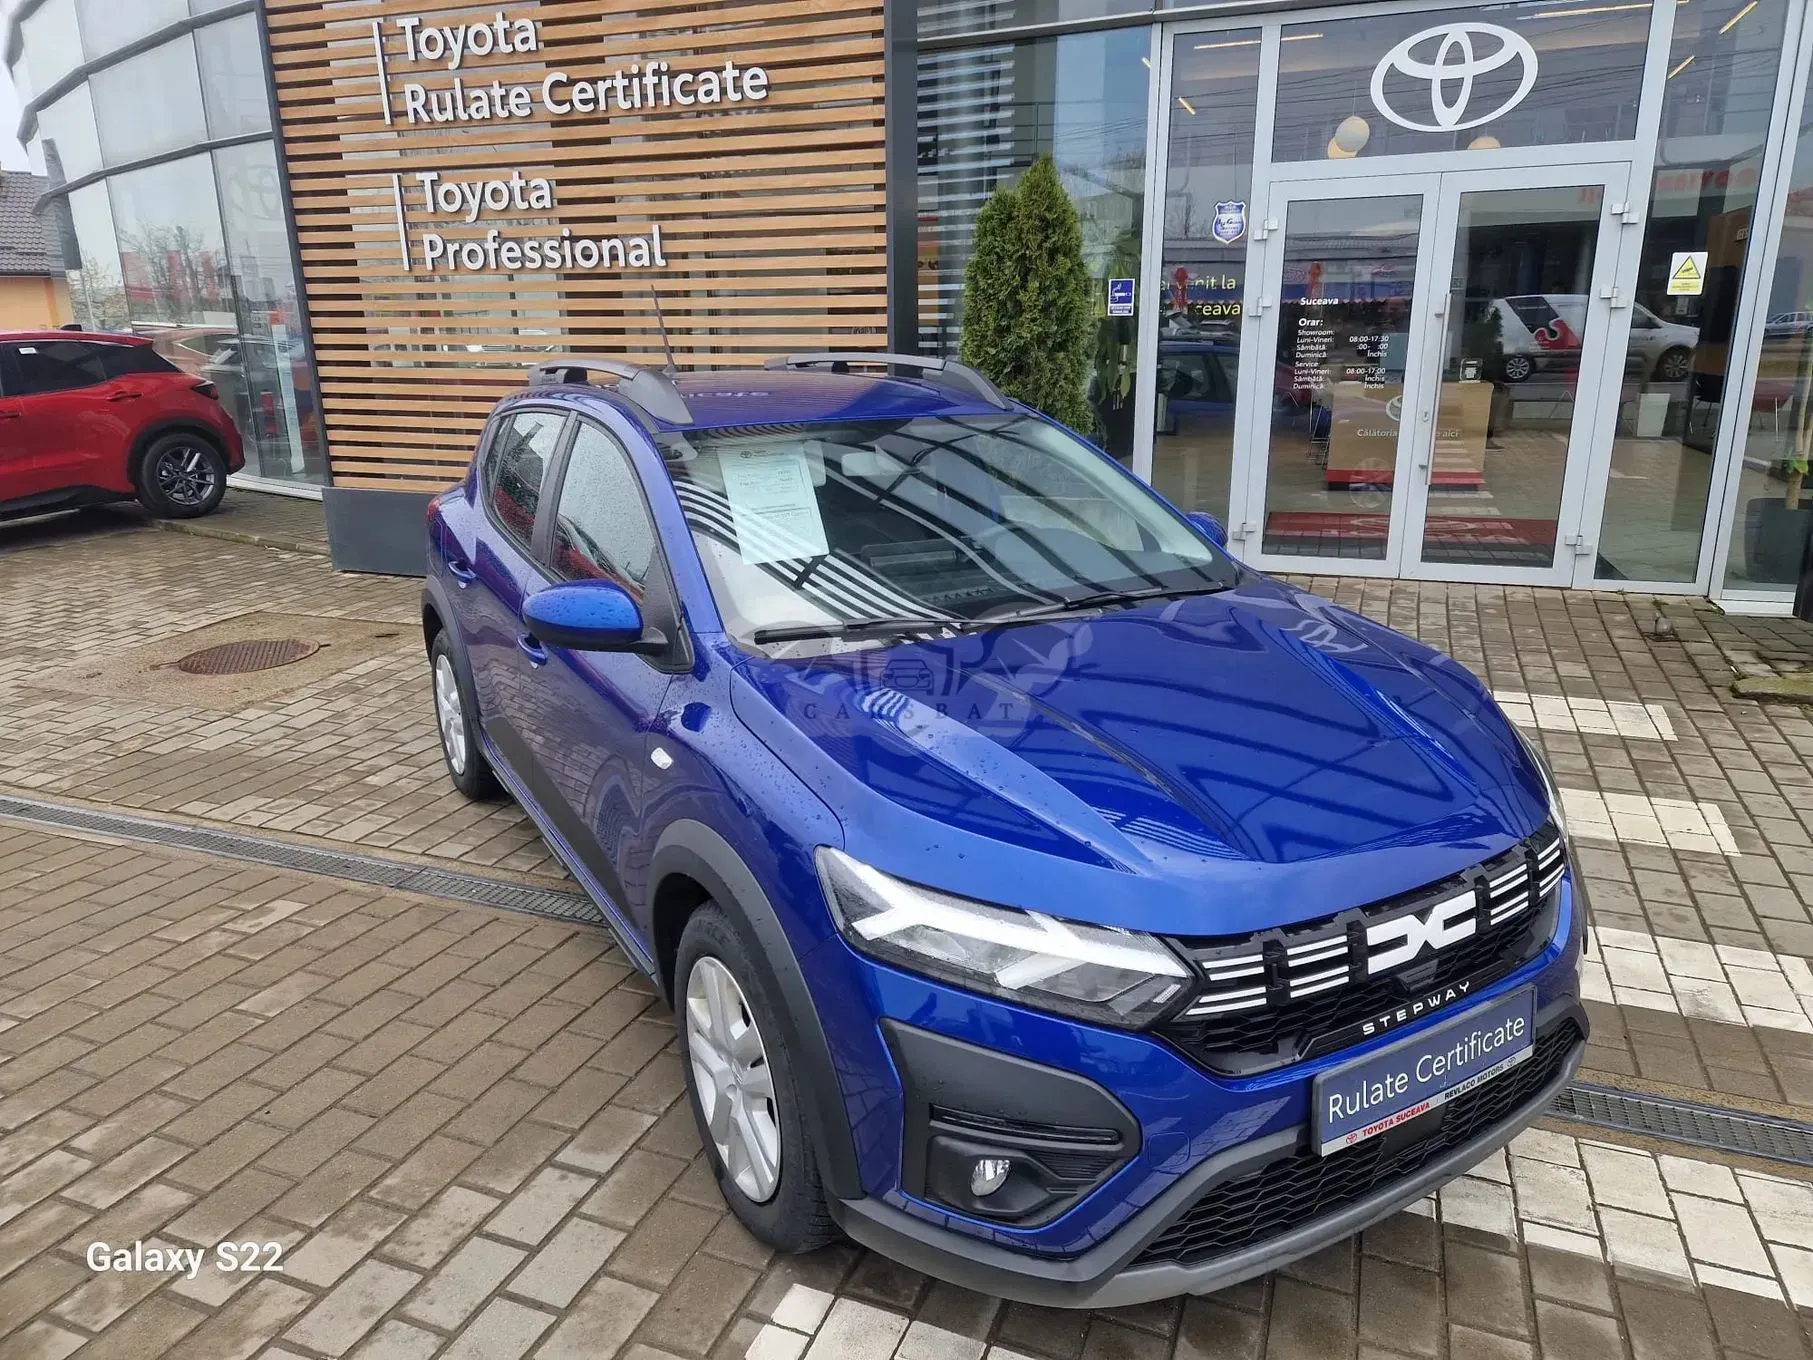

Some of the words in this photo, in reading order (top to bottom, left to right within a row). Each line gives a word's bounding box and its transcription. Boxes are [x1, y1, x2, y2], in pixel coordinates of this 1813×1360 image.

[396, 11, 538, 70] Toyota
[404, 77, 532, 125] Rulate
[541, 60, 769, 115] Certificate
[416, 170, 554, 223] Toyota
[422, 224, 668, 271] Professional
[1221, 274, 1236, 290] la
[1300, 297, 1339, 306] Suceava
[1298, 318, 1324, 327] Orar:
[1362, 981, 1470, 1036] STEPWAY
[1328, 1073, 1409, 1124] Rulate
[1415, 1016, 1526, 1083] Certificate
[1443, 1080, 1476, 1101] REVLACO
[1476, 1063, 1505, 1084] MOTORS
[1362, 1117, 1395, 1137] TOYOTA
[1395, 1102, 1431, 1123] SUCEAVA
